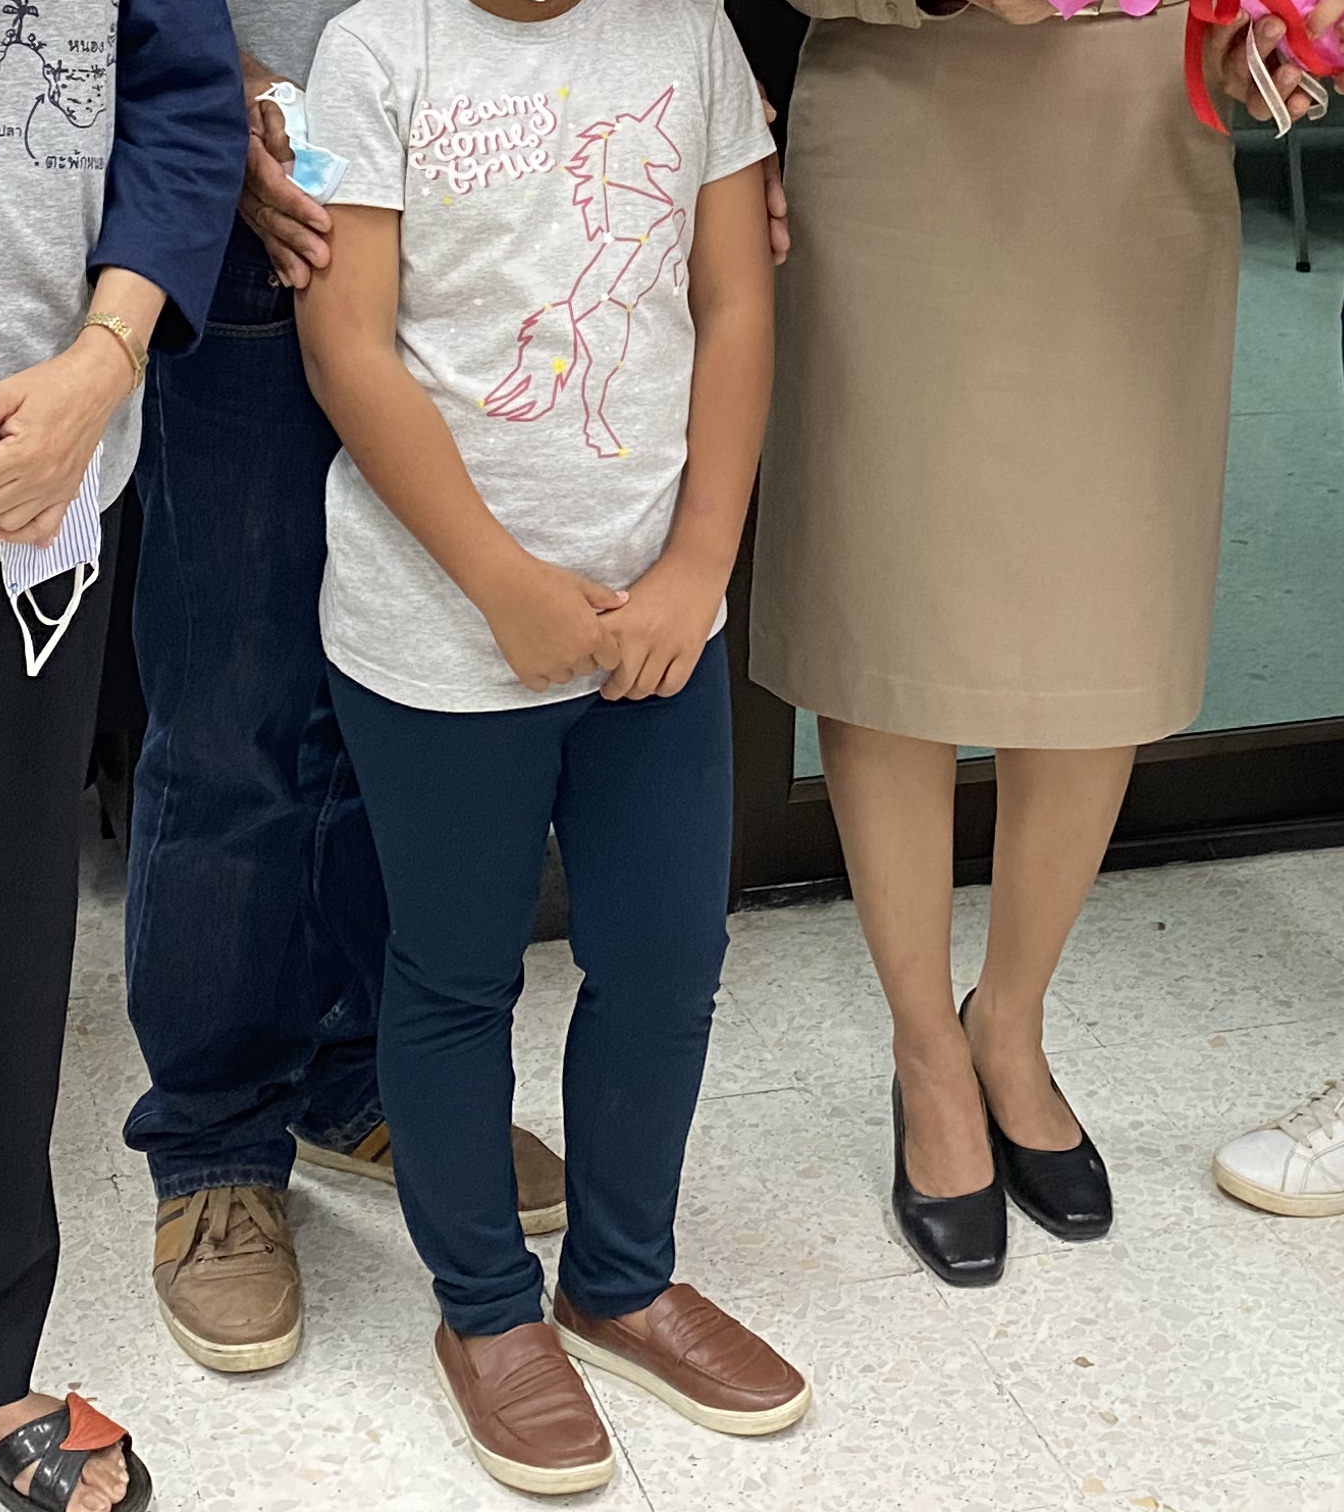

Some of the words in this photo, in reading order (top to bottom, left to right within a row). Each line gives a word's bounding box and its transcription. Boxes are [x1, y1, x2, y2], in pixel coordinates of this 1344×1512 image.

[68, 39, 106, 54] หนอง
[409, 93, 557, 148] Dreams
[434, 122, 543, 163] come
[409, 148, 557, 196] true
